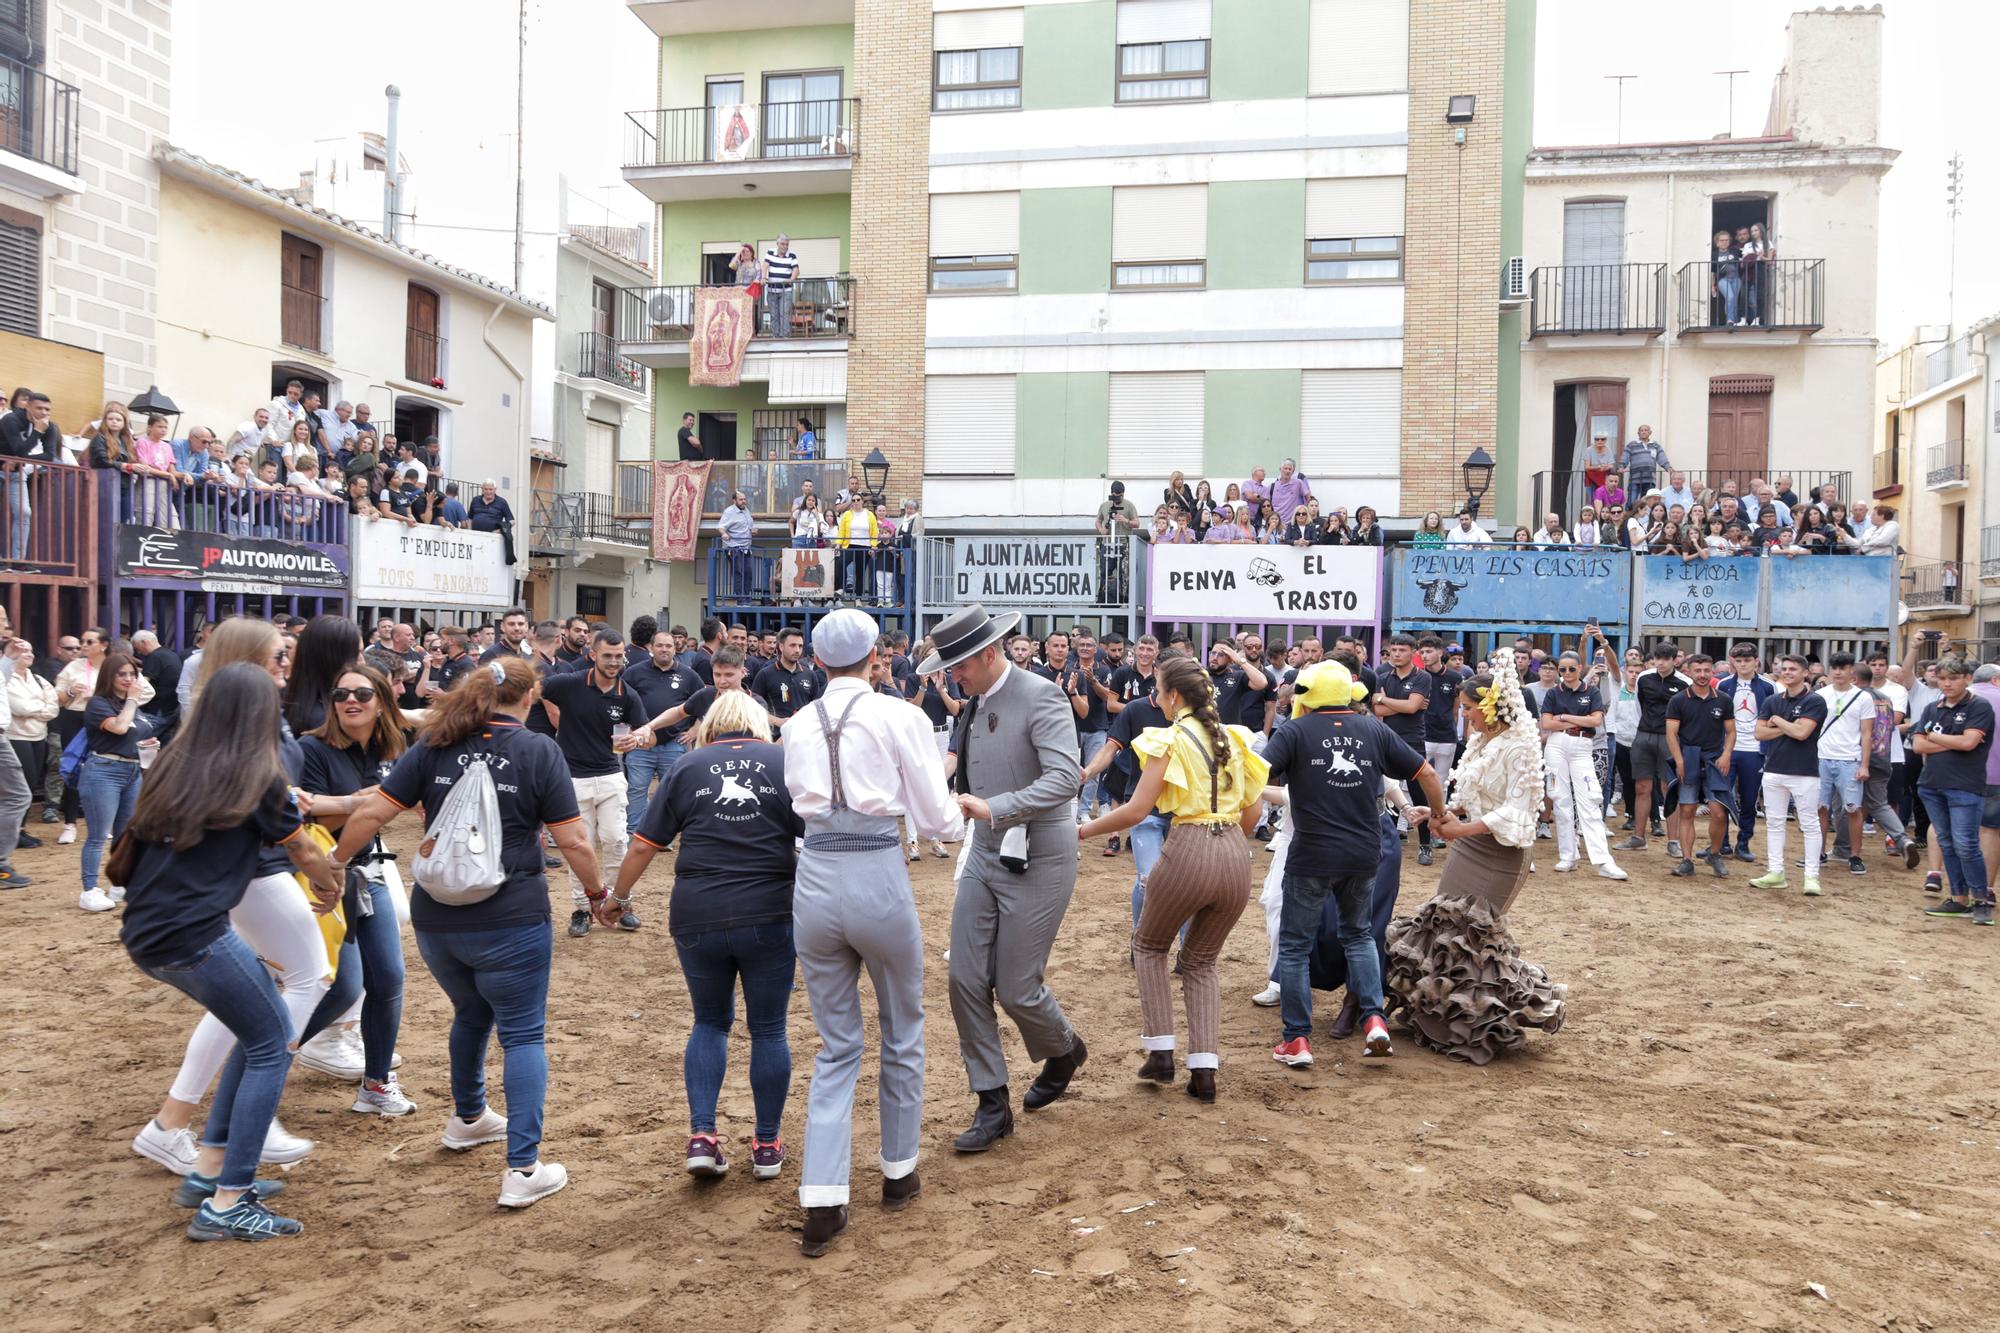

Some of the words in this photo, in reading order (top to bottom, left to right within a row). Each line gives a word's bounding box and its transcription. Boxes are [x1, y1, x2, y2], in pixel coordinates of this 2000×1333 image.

[400, 536, 473, 560] T'EMPUJEN
[965, 543, 1086, 566] AJUNTAMENT
[202, 547, 339, 573] JPAUTOMOVILE
[1303, 555, 1327, 575] EL
[1411, 555, 1475, 575] PENYA
[1486, 556, 1524, 576] ELS
[1534, 556, 1613, 578] CASATS
[378, 567, 415, 588] TOTS
[433, 573, 489, 593] TANGATS
[1170, 569, 1236, 591] PENYA
[1665, 561, 1740, 581] PENYA
[982, 572, 1092, 596] ALMASSORA
[1273, 590, 1358, 611] TRASTO
[1644, 601, 1751, 621] CARAGOL
[1322, 736, 1364, 749] GENT
[709, 759, 766, 775] GENT
[1311, 758, 1326, 766] DEL
[434, 775, 453, 785] DEL
[497, 782, 518, 793] BOU
[695, 787, 713, 798] DEL
[714, 811, 761, 822] ALMASSORA
